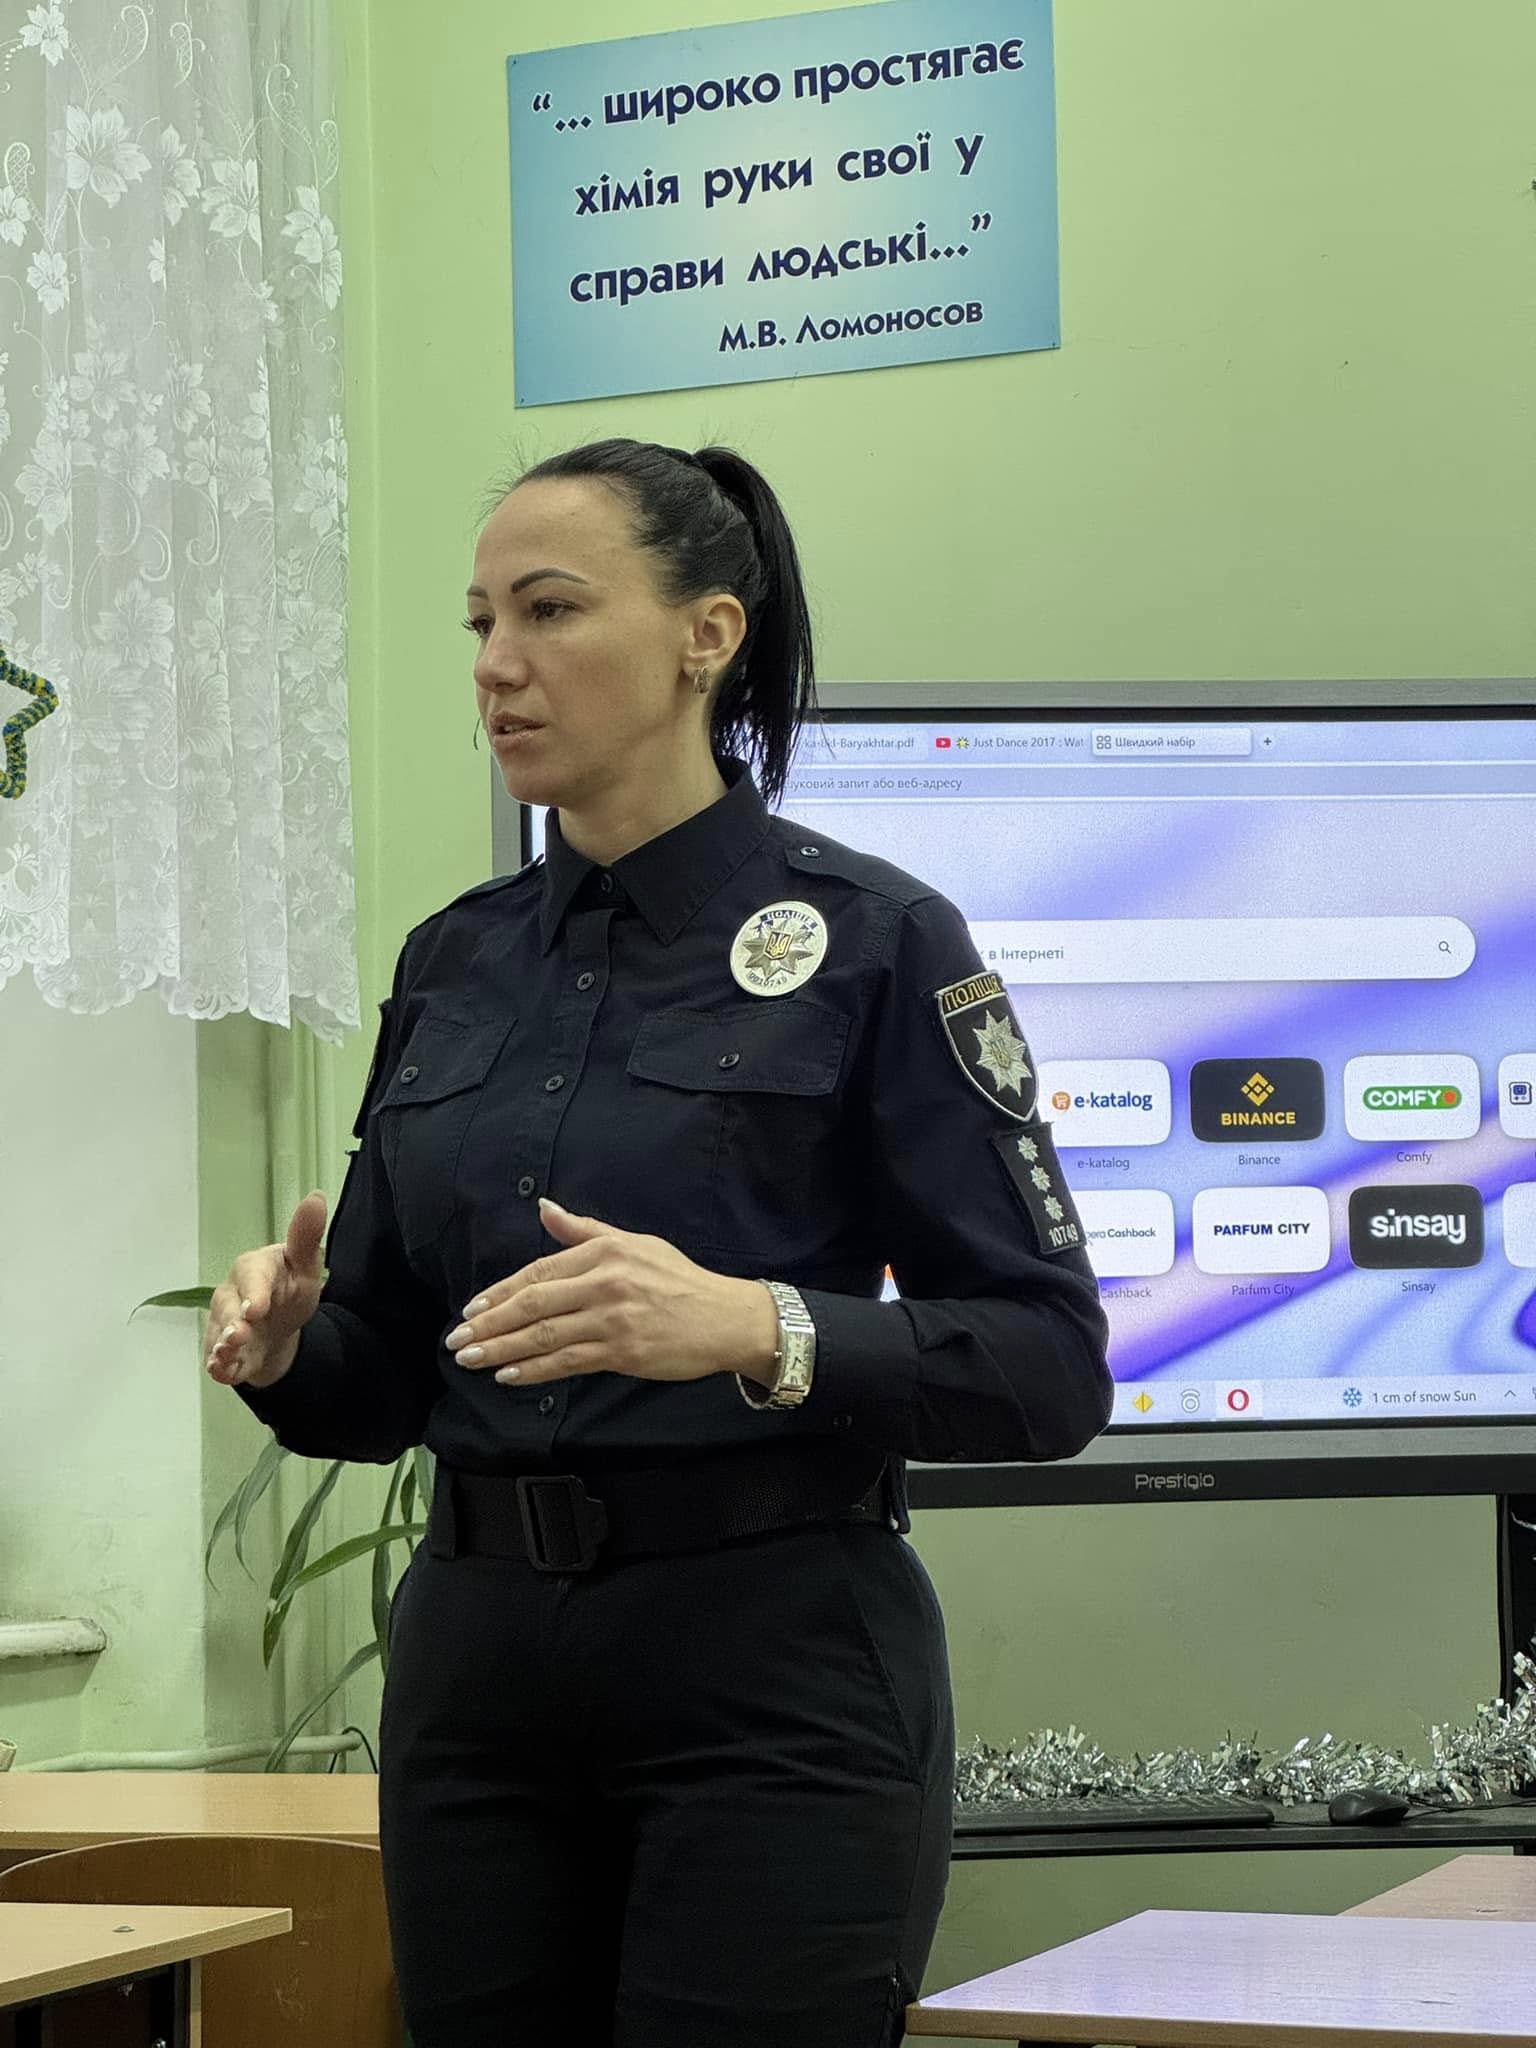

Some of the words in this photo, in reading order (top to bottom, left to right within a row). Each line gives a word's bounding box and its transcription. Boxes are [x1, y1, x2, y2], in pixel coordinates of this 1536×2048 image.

[604, 71, 781, 125] широко
[794, 37, 1024, 104] простягає
[575, 168, 680, 216] хімія
[704, 156, 812, 207] руки
[836, 131, 932, 183] свої
[954, 134, 984, 177] у
[570, 254, 724, 306] справи
[719, 320, 787, 353] М.В.
[796, 302, 985, 345] Ломоносов
[973, 737, 993, 748] Just
[996, 737, 1028, 748] Dance
[1031, 737, 1056, 748] 2017
[1115, 736, 1164, 750] Швидкий
[1166, 736, 1196, 750] набір
[838, 780, 869, 789] запит
[873, 776, 895, 790] або
[899, 776, 963, 793] веб-адресу
[1001, 946, 1065, 963] Інтернеті
[1368, 1089, 1443, 1107] COMFY
[1220, 1111, 1297, 1126] BINANCE
[1077, 1157, 1131, 1171] e-katalog
[1238, 1154, 1281, 1166] Binance
[1396, 1151, 1432, 1165] Comfy
[1107, 1227, 1156, 1239] Cashback
[1213, 1223, 1273, 1236] PARFUM
[1277, 1222, 1311, 1235] CITY
[1370, 1208, 1467, 1245] sinsay
[1048, 1222, 1080, 1247] 10749
[1231, 1285, 1271, 1296] Parfum
[1273, 1284, 1295, 1297] City
[1401, 1280, 1436, 1293] Sinsay
[1373, 1391, 1379, 1403] 1
[1382, 1394, 1401, 1403] cm
[1404, 1390, 1418, 1403] of
[1419, 1392, 1450, 1402] snow
[1454, 1390, 1477, 1402] Sun
[1135, 1472, 1215, 1491] Prestigio
